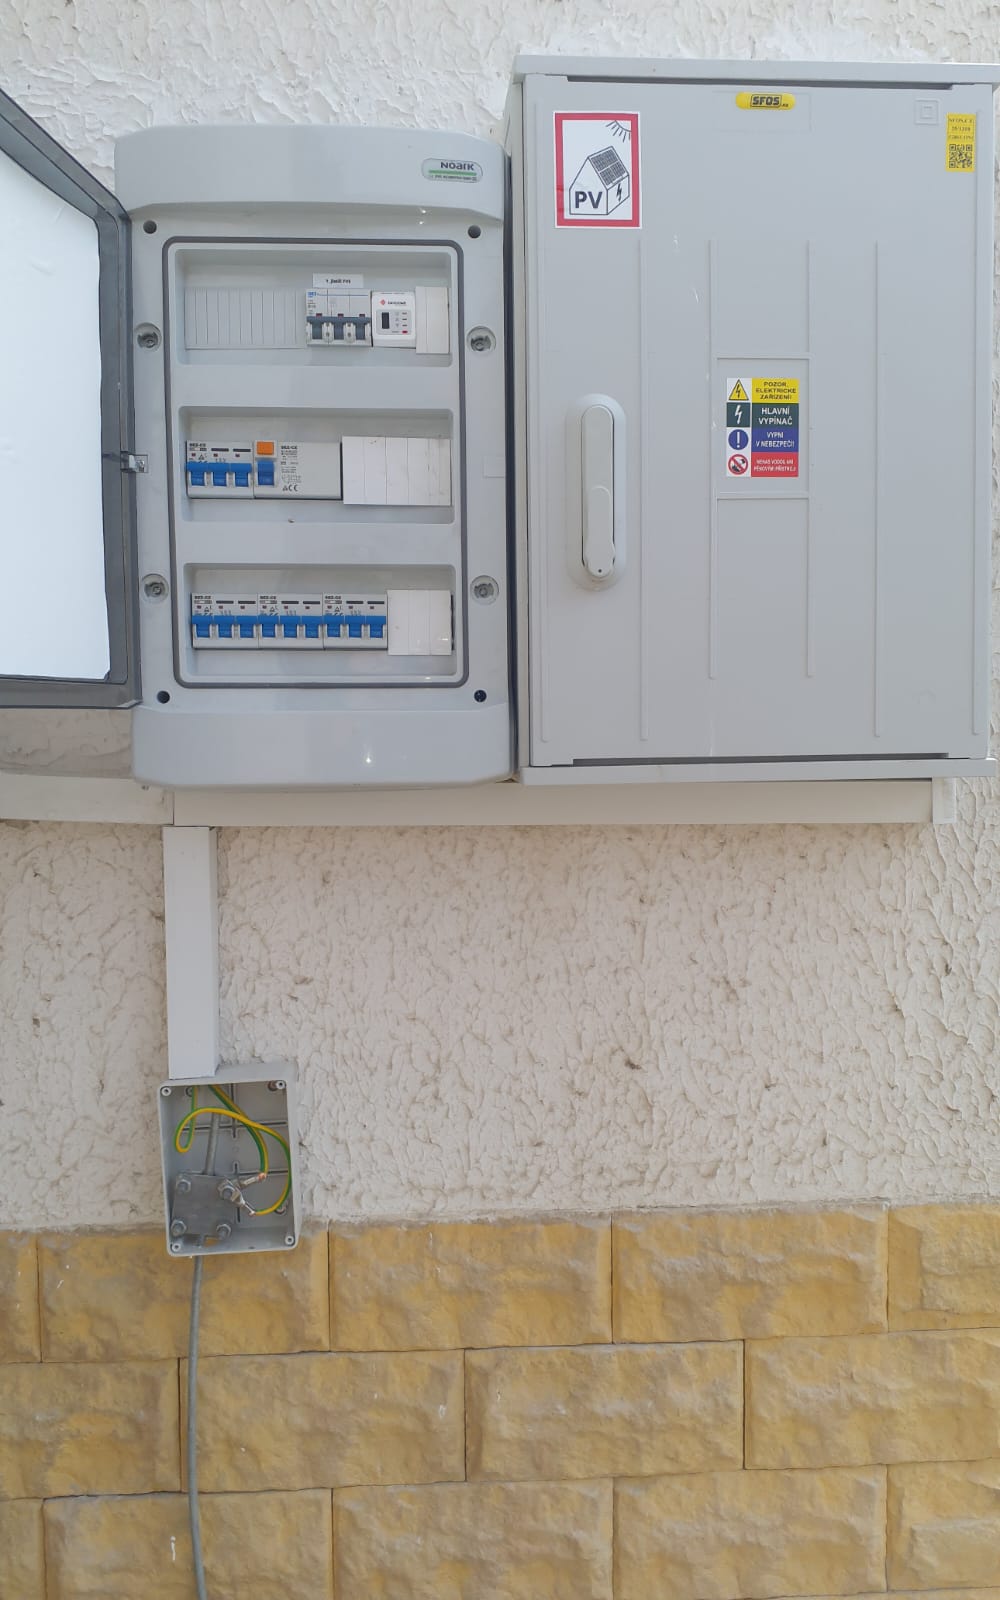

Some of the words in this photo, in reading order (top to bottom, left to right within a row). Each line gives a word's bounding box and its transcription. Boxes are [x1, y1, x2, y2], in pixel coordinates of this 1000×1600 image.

[575, 191, 602, 208] PV
[761, 405, 790, 415] HLAVNÍ
[758, 415, 793, 425] VYPÍNAČ
